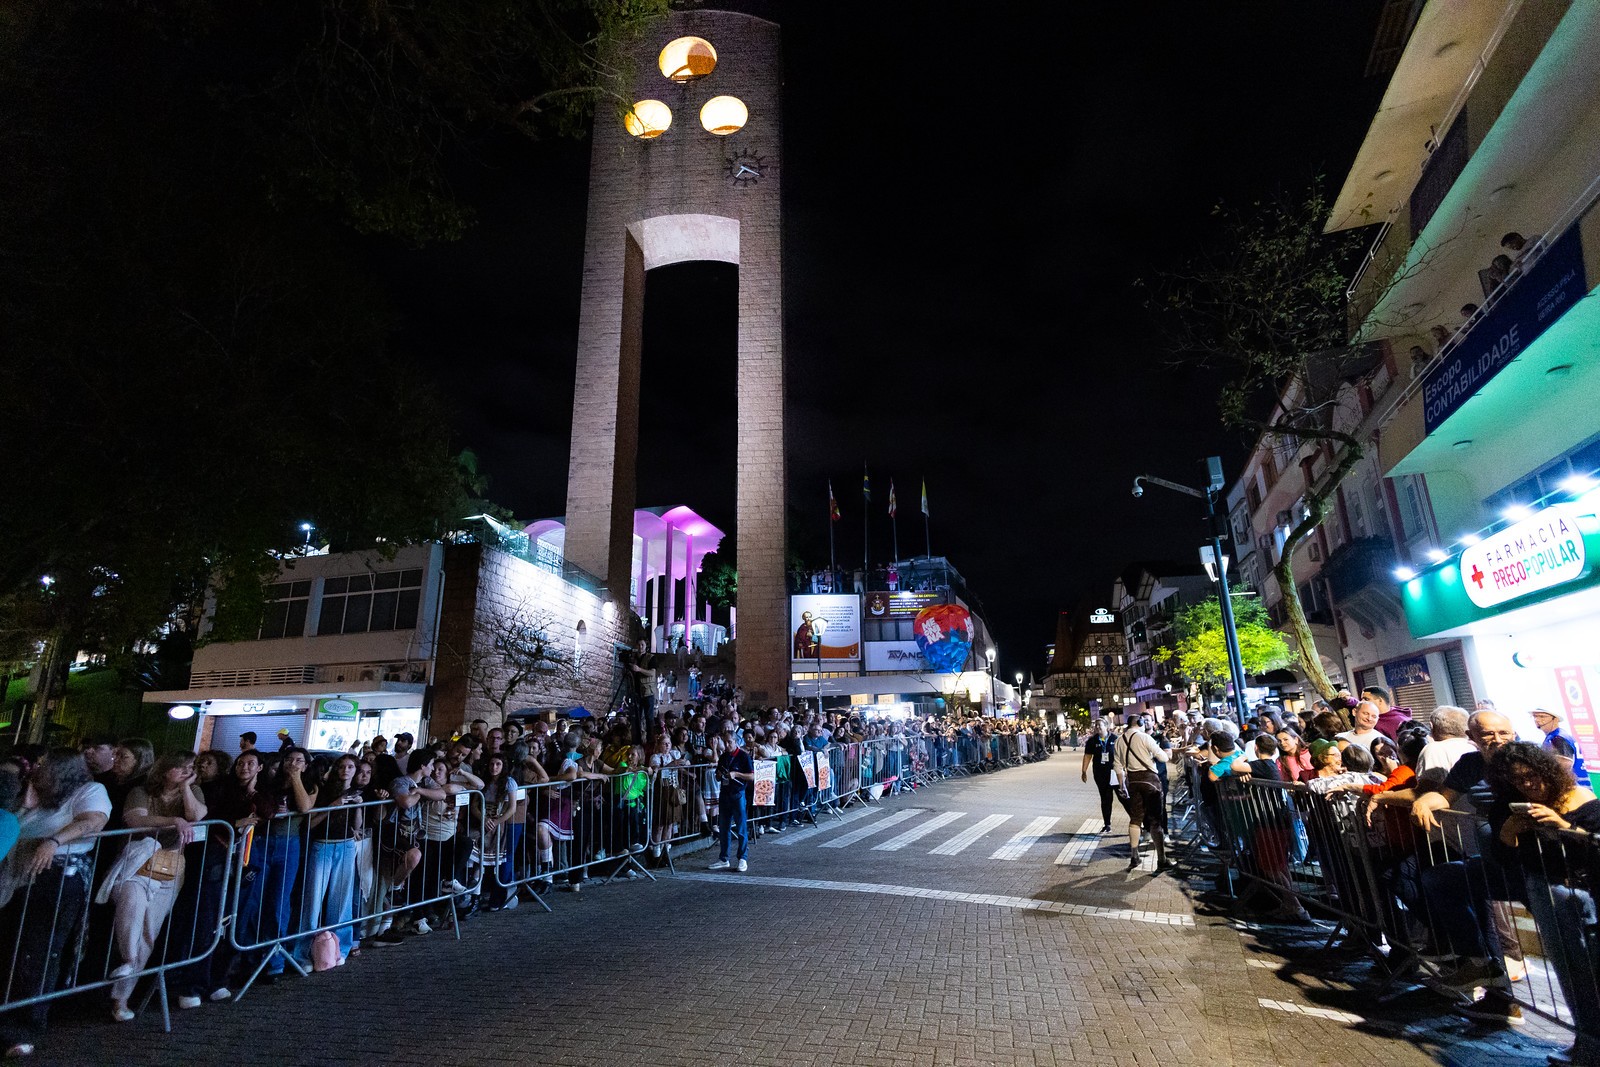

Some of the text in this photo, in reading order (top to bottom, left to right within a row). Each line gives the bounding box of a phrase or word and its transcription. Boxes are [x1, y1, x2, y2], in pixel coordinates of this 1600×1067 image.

[1424, 359, 1462, 404] Escopo
[1426, 323, 1520, 423] CONTABILIDADE
[1090, 614, 1115, 624] HAVAN
[887, 650, 924, 661] AVANC
